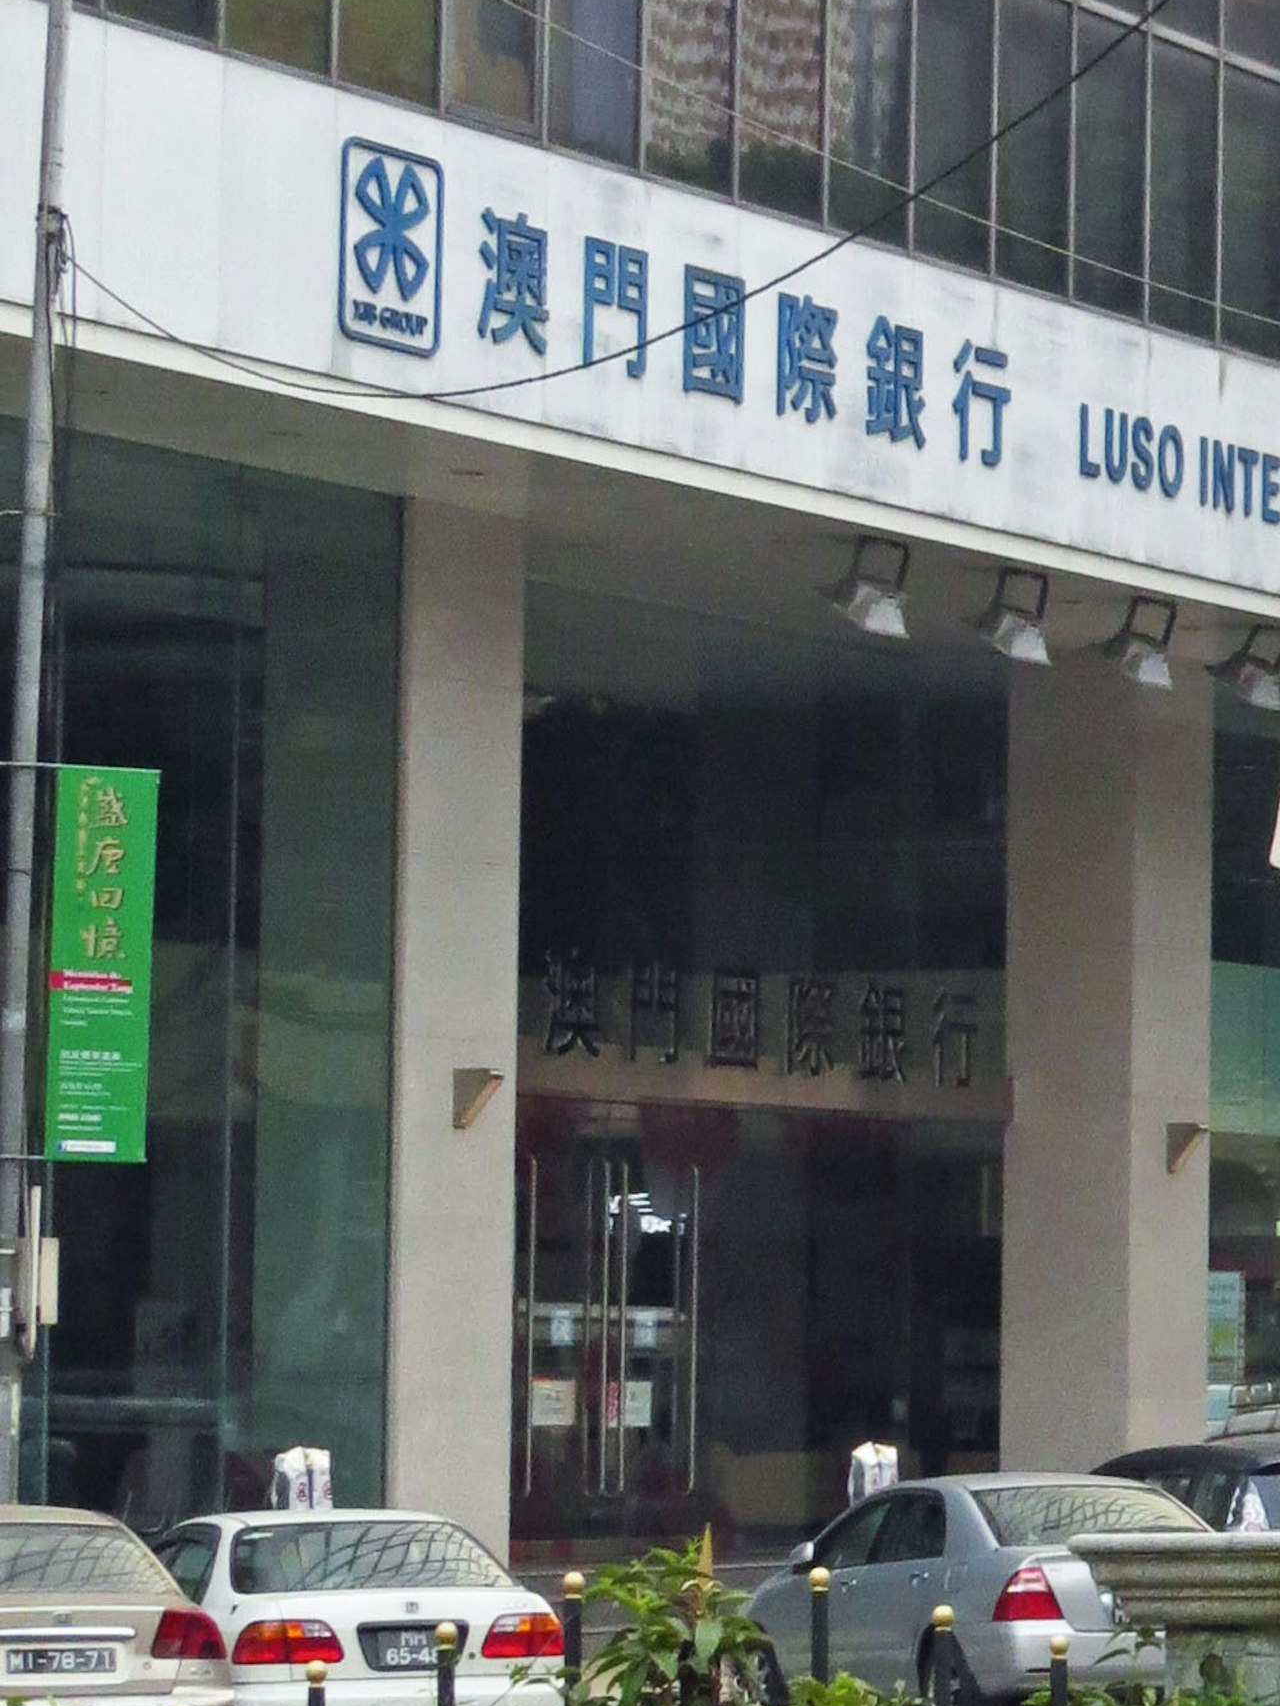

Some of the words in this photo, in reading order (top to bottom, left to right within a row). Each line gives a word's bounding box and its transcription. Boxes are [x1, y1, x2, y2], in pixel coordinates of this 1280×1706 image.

[476, 205, 1011, 467] 澳門國際銀行
[1078, 402, 1183, 498] LUSO
[8, 1650, 111, 1672] MI-78-71
